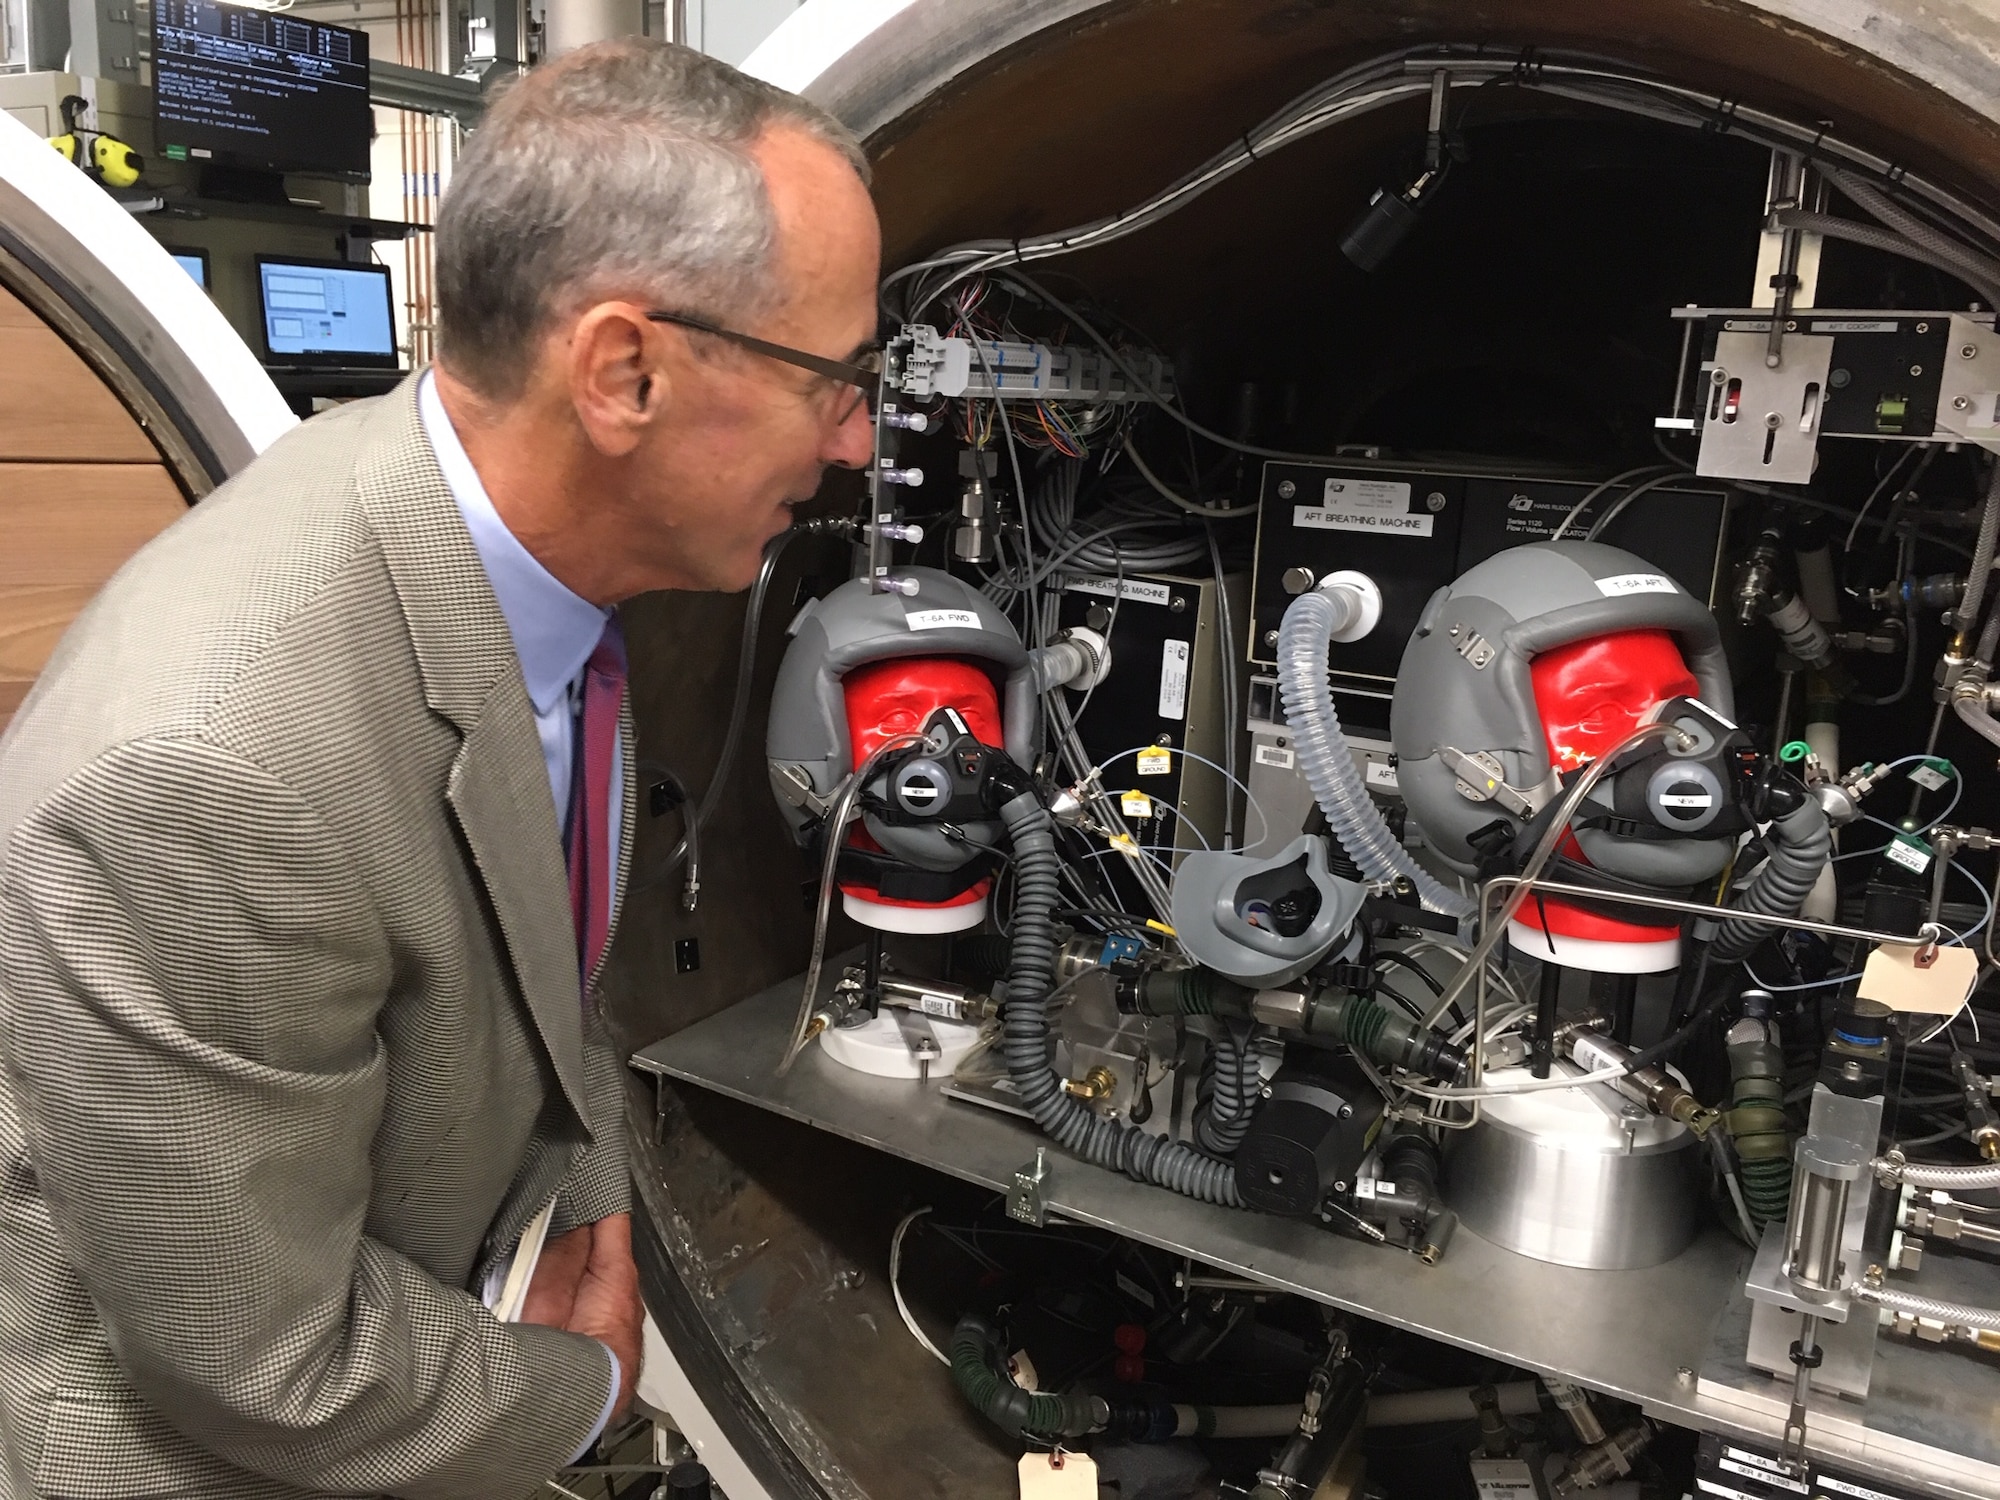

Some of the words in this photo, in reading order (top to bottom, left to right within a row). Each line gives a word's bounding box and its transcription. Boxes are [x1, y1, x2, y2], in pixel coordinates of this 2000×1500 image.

[1304, 512, 1322, 520] AFT
[1325, 514, 1376, 526] BREATHING
[1380, 518, 1422, 529] MACHINE
[1068, 576, 1085, 585] FWD
[1132, 586, 1166, 598] MACHINE
[1613, 580, 1641, 589] T-6A
[948, 614, 970, 622] FWD
[1378, 770, 1396, 780] AFT
[1904, 847, 1918, 856] AFT
[1892, 851, 1921, 869] GROUND
[1748, 1456, 1767, 1466] T-6A
[1738, 1466, 1754, 1476] SER
[1836, 1482, 1856, 1494] FWD
